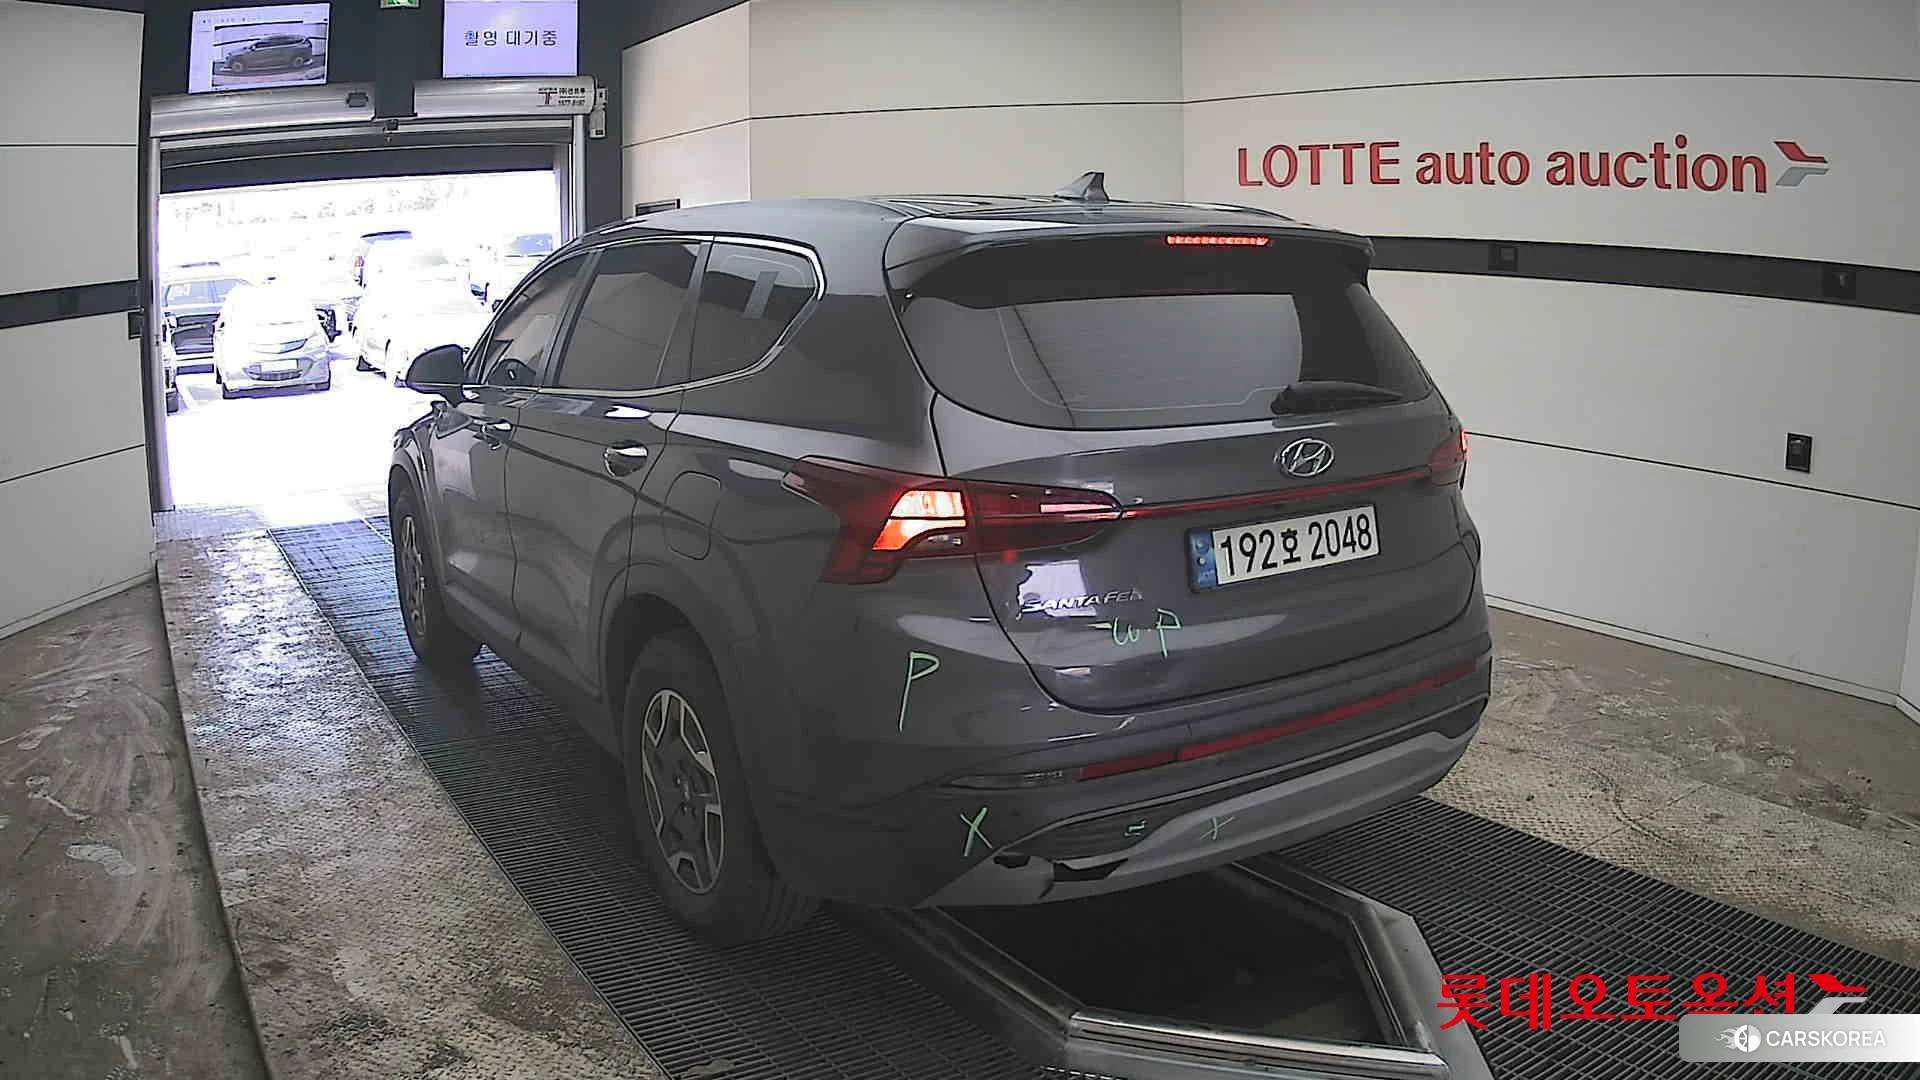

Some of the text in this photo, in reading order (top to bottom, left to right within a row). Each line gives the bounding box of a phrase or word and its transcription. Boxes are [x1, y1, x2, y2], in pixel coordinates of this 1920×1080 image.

[506, 30, 557, 46] 대기중
[1238, 134, 1768, 193] LOTTE auto auction
[1220, 513, 1372, 576] 192호 2048
[899, 651, 941, 732] P
